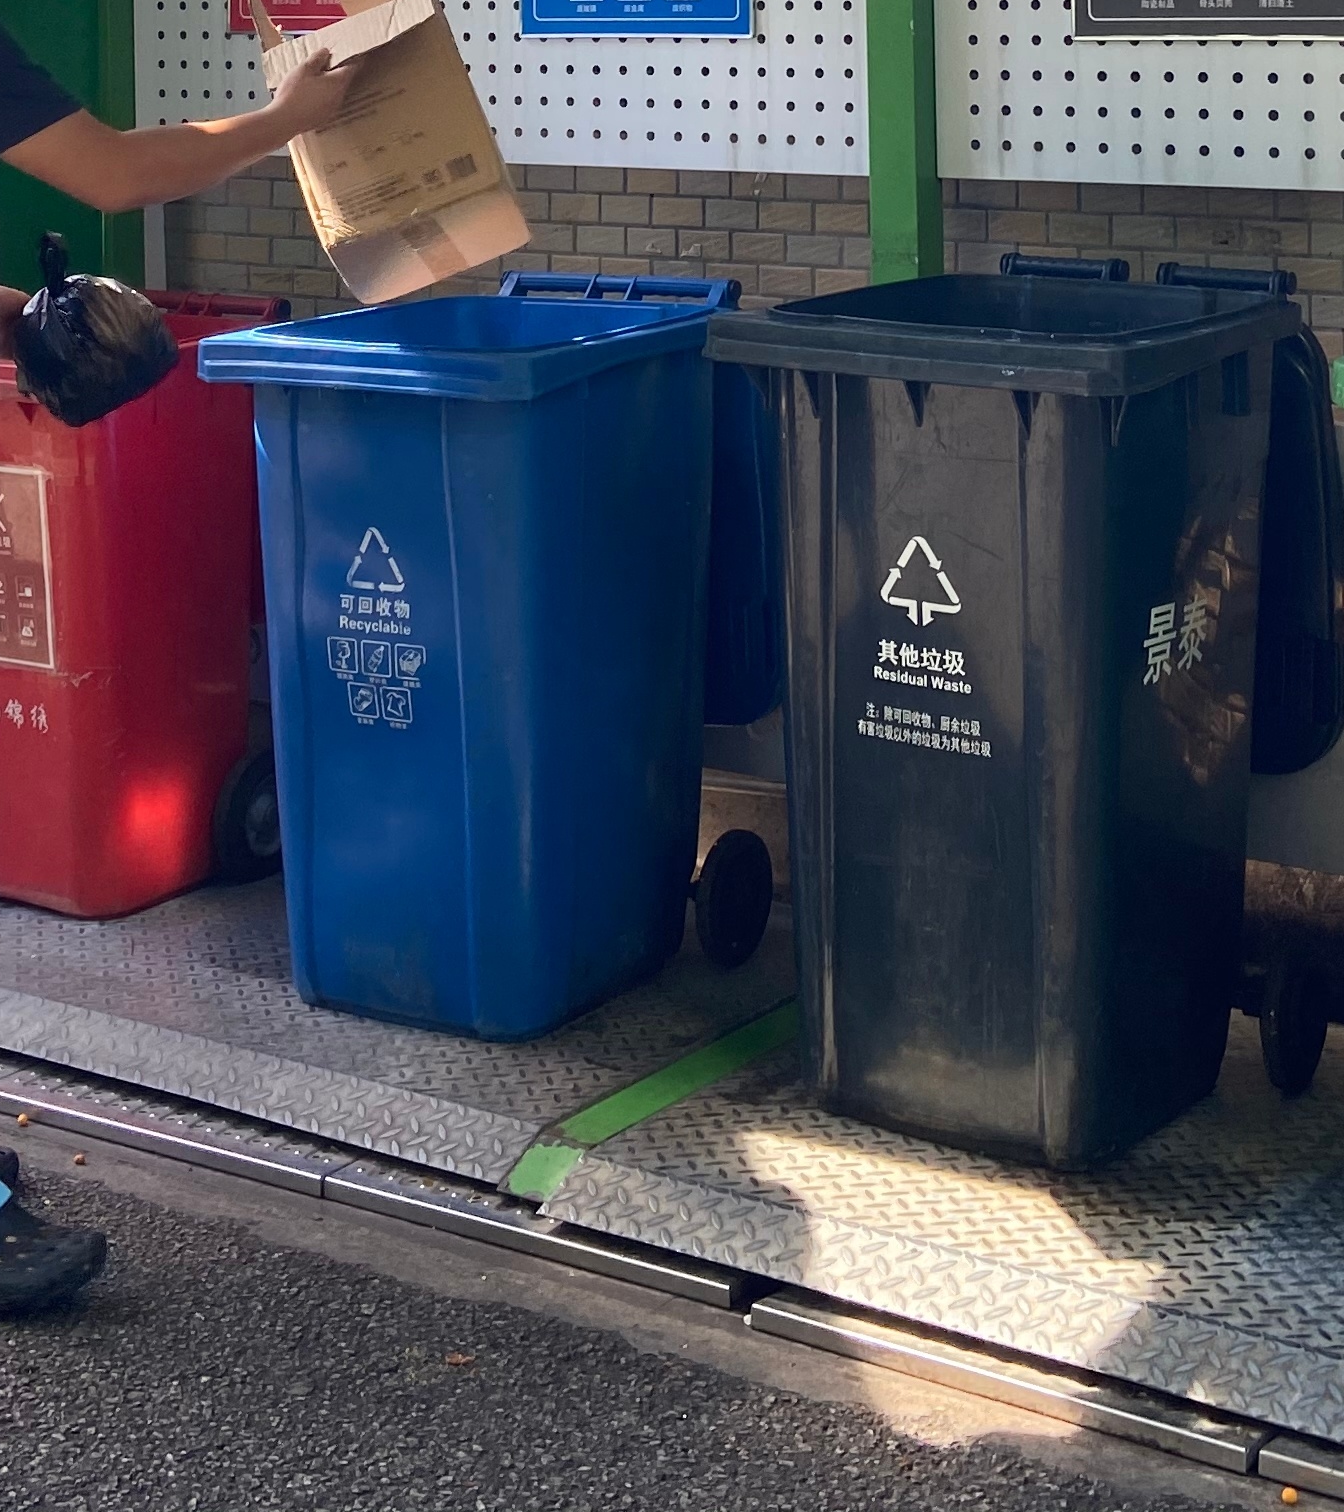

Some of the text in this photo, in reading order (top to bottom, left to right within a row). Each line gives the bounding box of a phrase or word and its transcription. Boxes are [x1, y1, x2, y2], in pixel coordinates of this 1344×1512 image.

[340, 594, 411, 619] 可回收物
[339, 615, 412, 635] Recyclable
[1143, 593, 1208, 686] 景泰
[877, 638, 966, 676] 其他垃圾
[873, 665, 973, 694] Residual Waste
